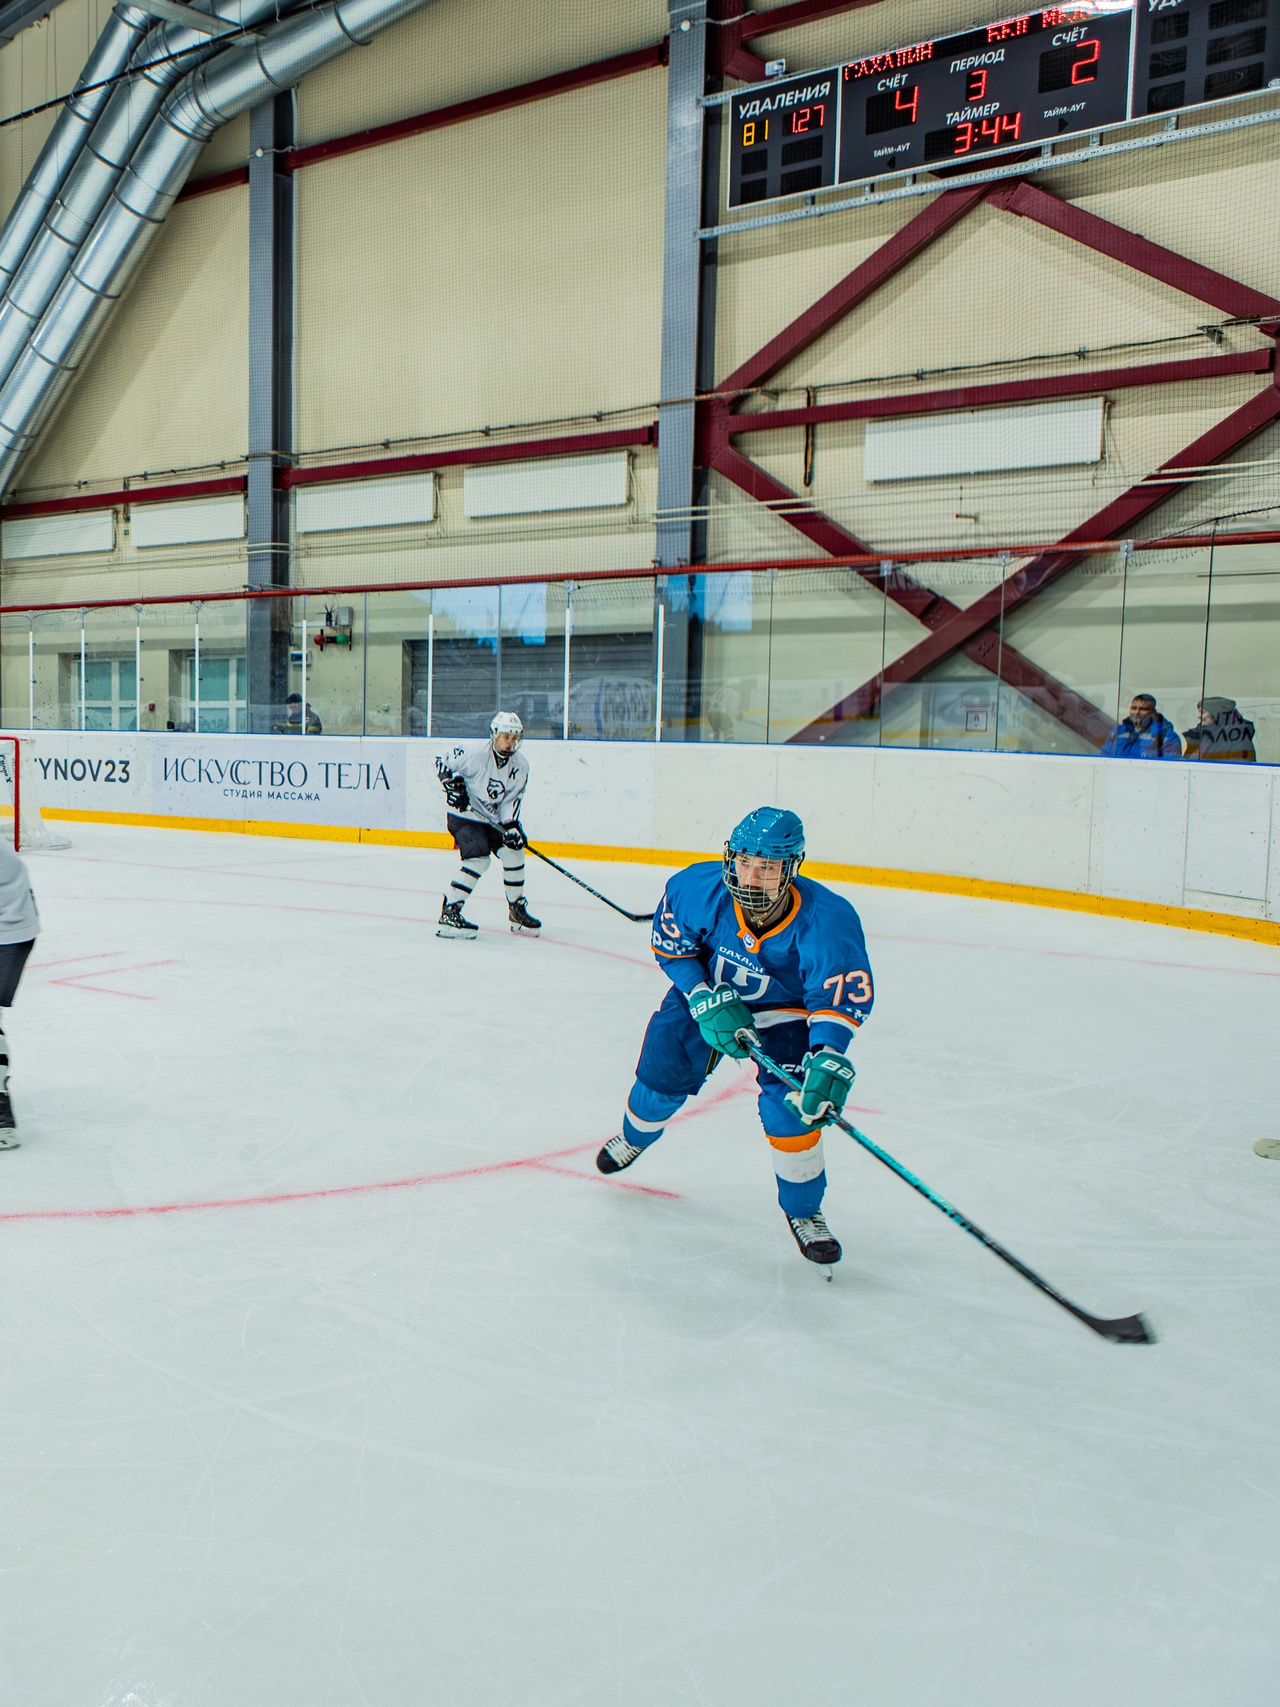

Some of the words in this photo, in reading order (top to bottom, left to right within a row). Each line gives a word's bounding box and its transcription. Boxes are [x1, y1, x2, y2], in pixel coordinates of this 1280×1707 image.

[1052, 26, 1088, 47] СЧЁТ
[949, 48, 1005, 74] ПЕРИОД
[1071, 38, 1101, 85] 2
[876, 73, 909, 92] СЧЁТ
[968, 69, 988, 101] 3
[738, 80, 831, 119] УДАЛЕНИЯ
[894, 85, 919, 123] 4
[945, 101, 1000, 125] ТАЙМЕР
[1043, 101, 1086, 119] ТАЙМ-АУТ
[742, 119, 769, 147] 81
[954, 111, 1022, 155] 3:44
[873, 142, 910, 158] ТАЙМ-АУТ
[163, 757, 309, 787] ИСКУССТВО
[318, 762, 391, 790] ТЕЛА
[223, 788, 262, 799] СТУДИЯ
[267, 791, 320, 801] МАССАЖА
[719, 946, 767, 974] САХАЛИ
[823, 970, 873, 1007] 73
